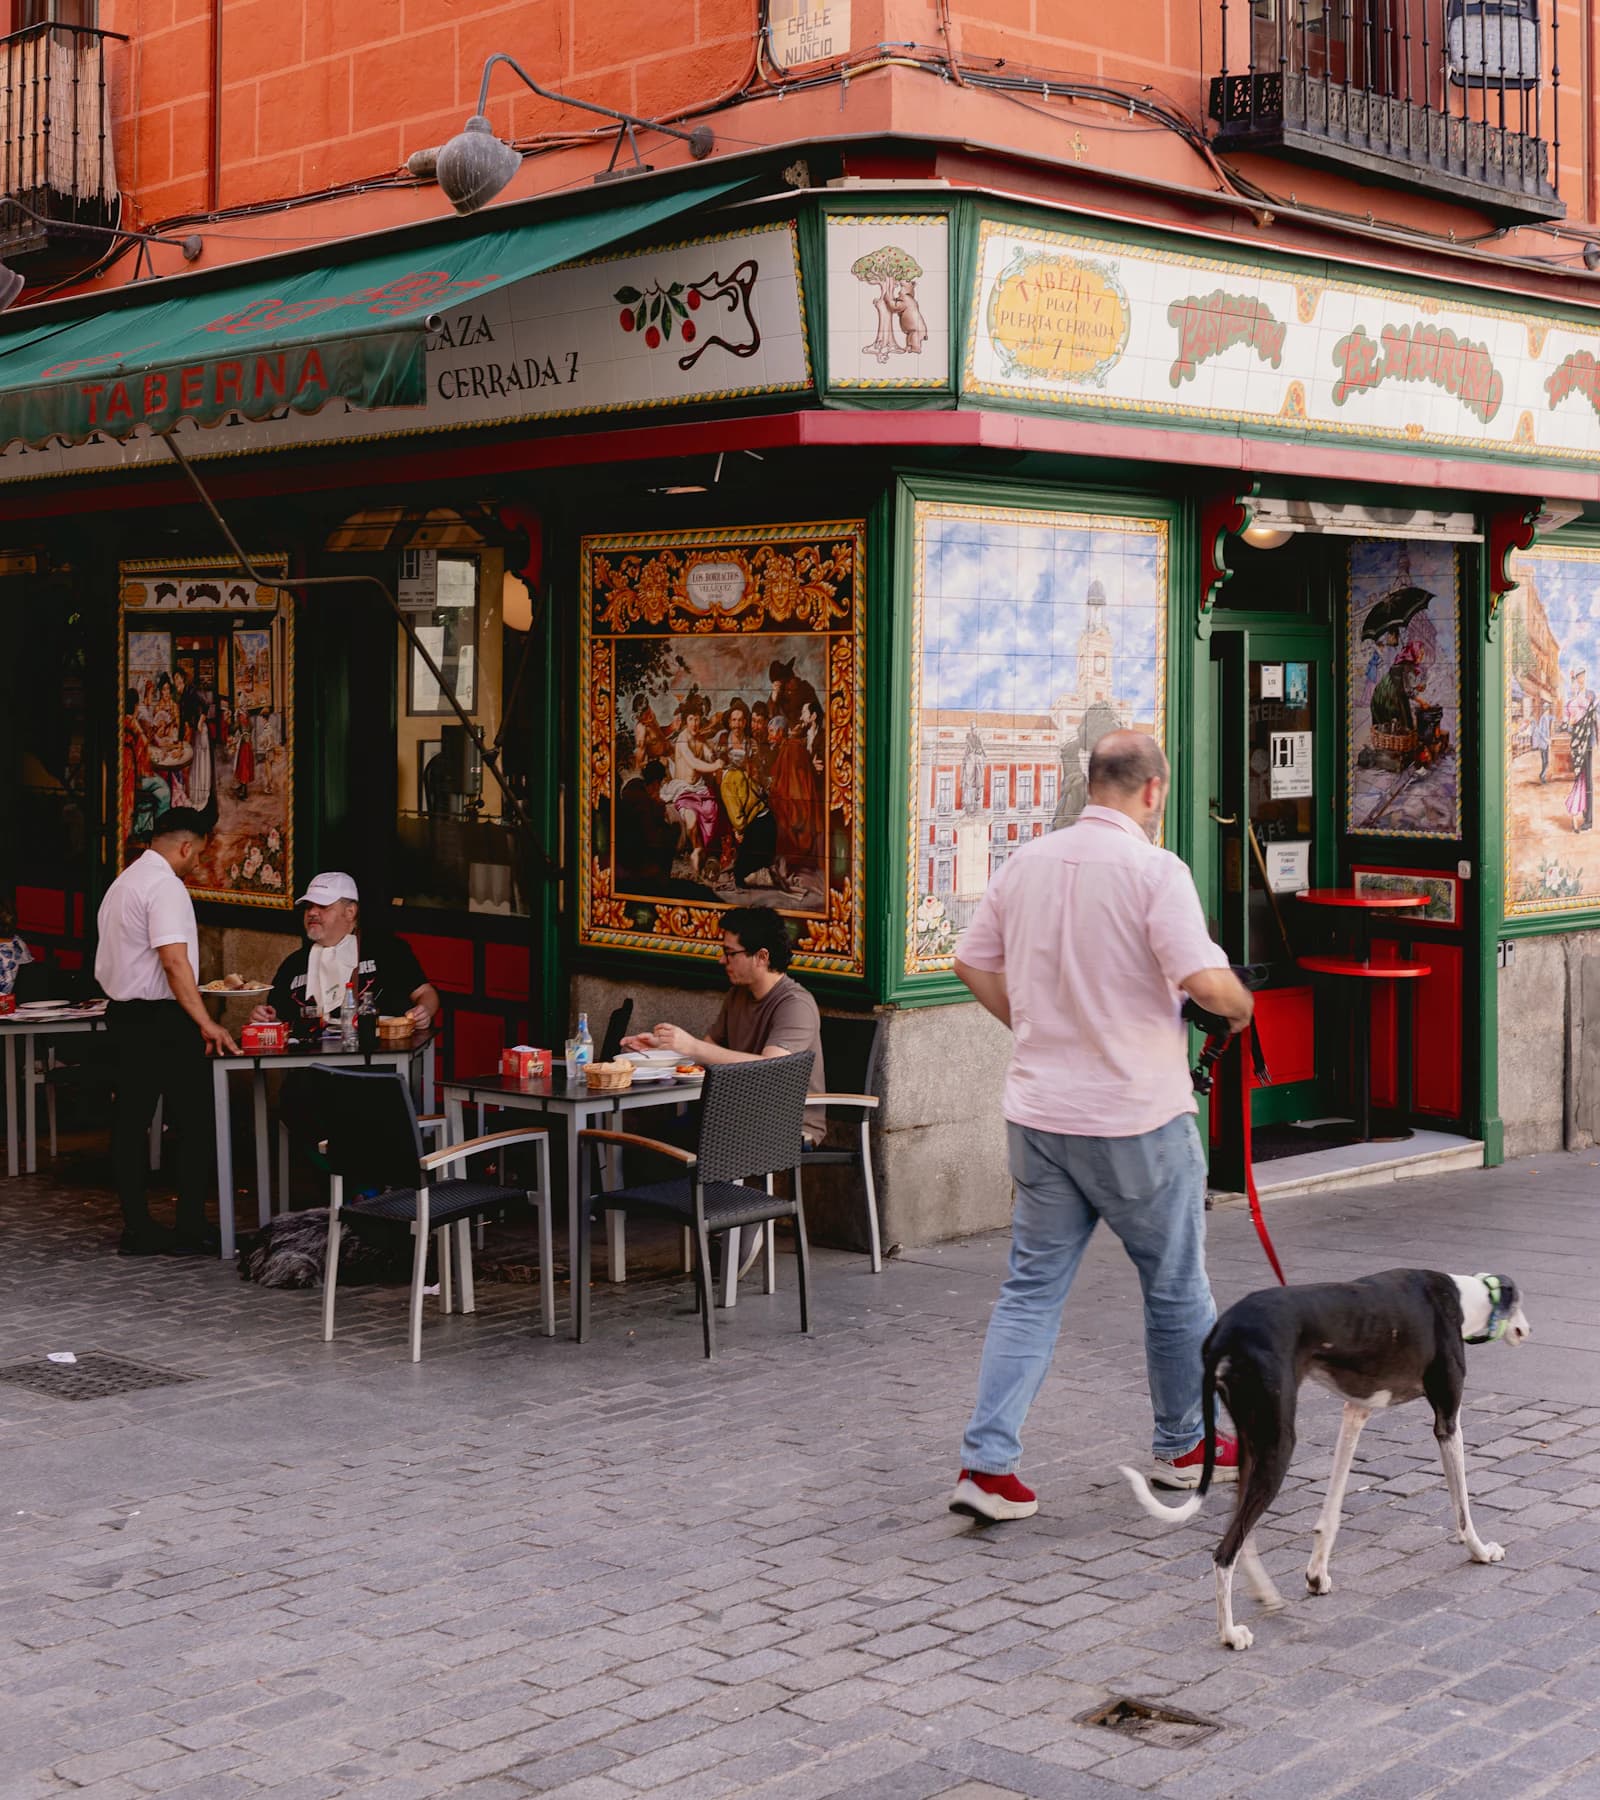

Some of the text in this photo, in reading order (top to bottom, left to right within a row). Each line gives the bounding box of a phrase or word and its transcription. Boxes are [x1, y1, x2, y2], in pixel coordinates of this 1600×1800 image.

[789, 8, 831, 35] CALLE
[799, 30, 819, 44] DEL
[785, 38, 832, 65] NUNCIO
[1046, 298, 1079, 314] PLAZA
[1000, 310, 1116, 340] PUERTA CERRADA
[1053, 338, 1063, 360] 7
[438, 351, 580, 400] CERRADA 7
[1334, 327, 1382, 404] EL
[81, 348, 329, 426] TABERNA
